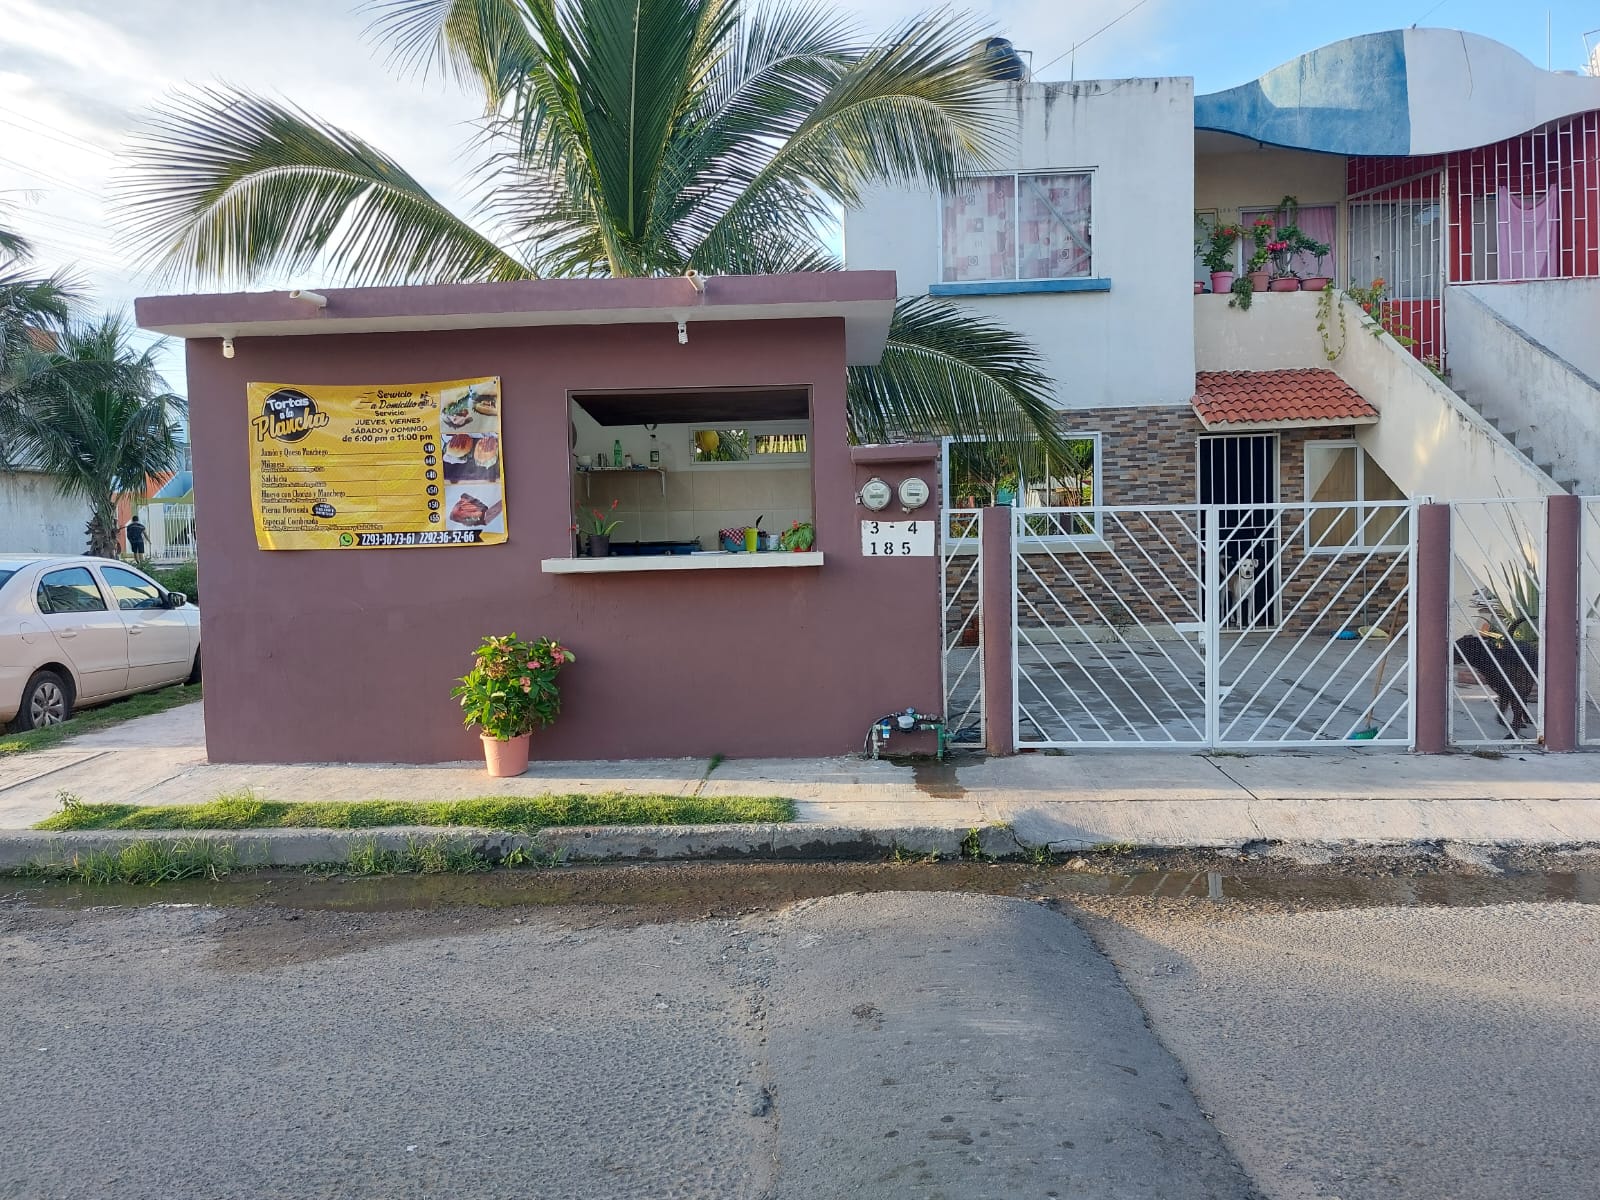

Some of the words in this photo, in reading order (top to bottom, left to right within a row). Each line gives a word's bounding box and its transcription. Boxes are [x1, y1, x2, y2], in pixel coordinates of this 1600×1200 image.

[376, 389, 413, 399] Servicio
[266, 398, 310, 411] Tortas
[378, 399, 417, 410] Domicilio
[279, 412, 285, 420] a
[285, 407, 295, 418] la
[252, 407, 330, 442] Plancha
[391, 425, 428, 434] DOMINGO
[342, 434, 353, 442] de
[354, 434, 373, 442] 6:00
[374, 436, 388, 444] pm
[397, 433, 418, 441] 11:00
[419, 434, 433, 442] pm
[283, 447, 301, 458] Queso
[302, 447, 329, 457] Manchego
[261, 460, 285, 468] Milanesa
[261, 474, 288, 483] Salchicha
[261, 489, 280, 498] Huevo
[292, 488, 312, 498] Chorizo
[317, 488, 346, 498] Manchego
[261, 505, 281, 514] Pierna
[282, 505, 309, 514] Horneada
[262, 516, 287, 526] Especial
[287, 516, 319, 526] Combinada
[361, 533, 415, 546] 2293-30-73-61
[870, 541, 911, 555] 185
